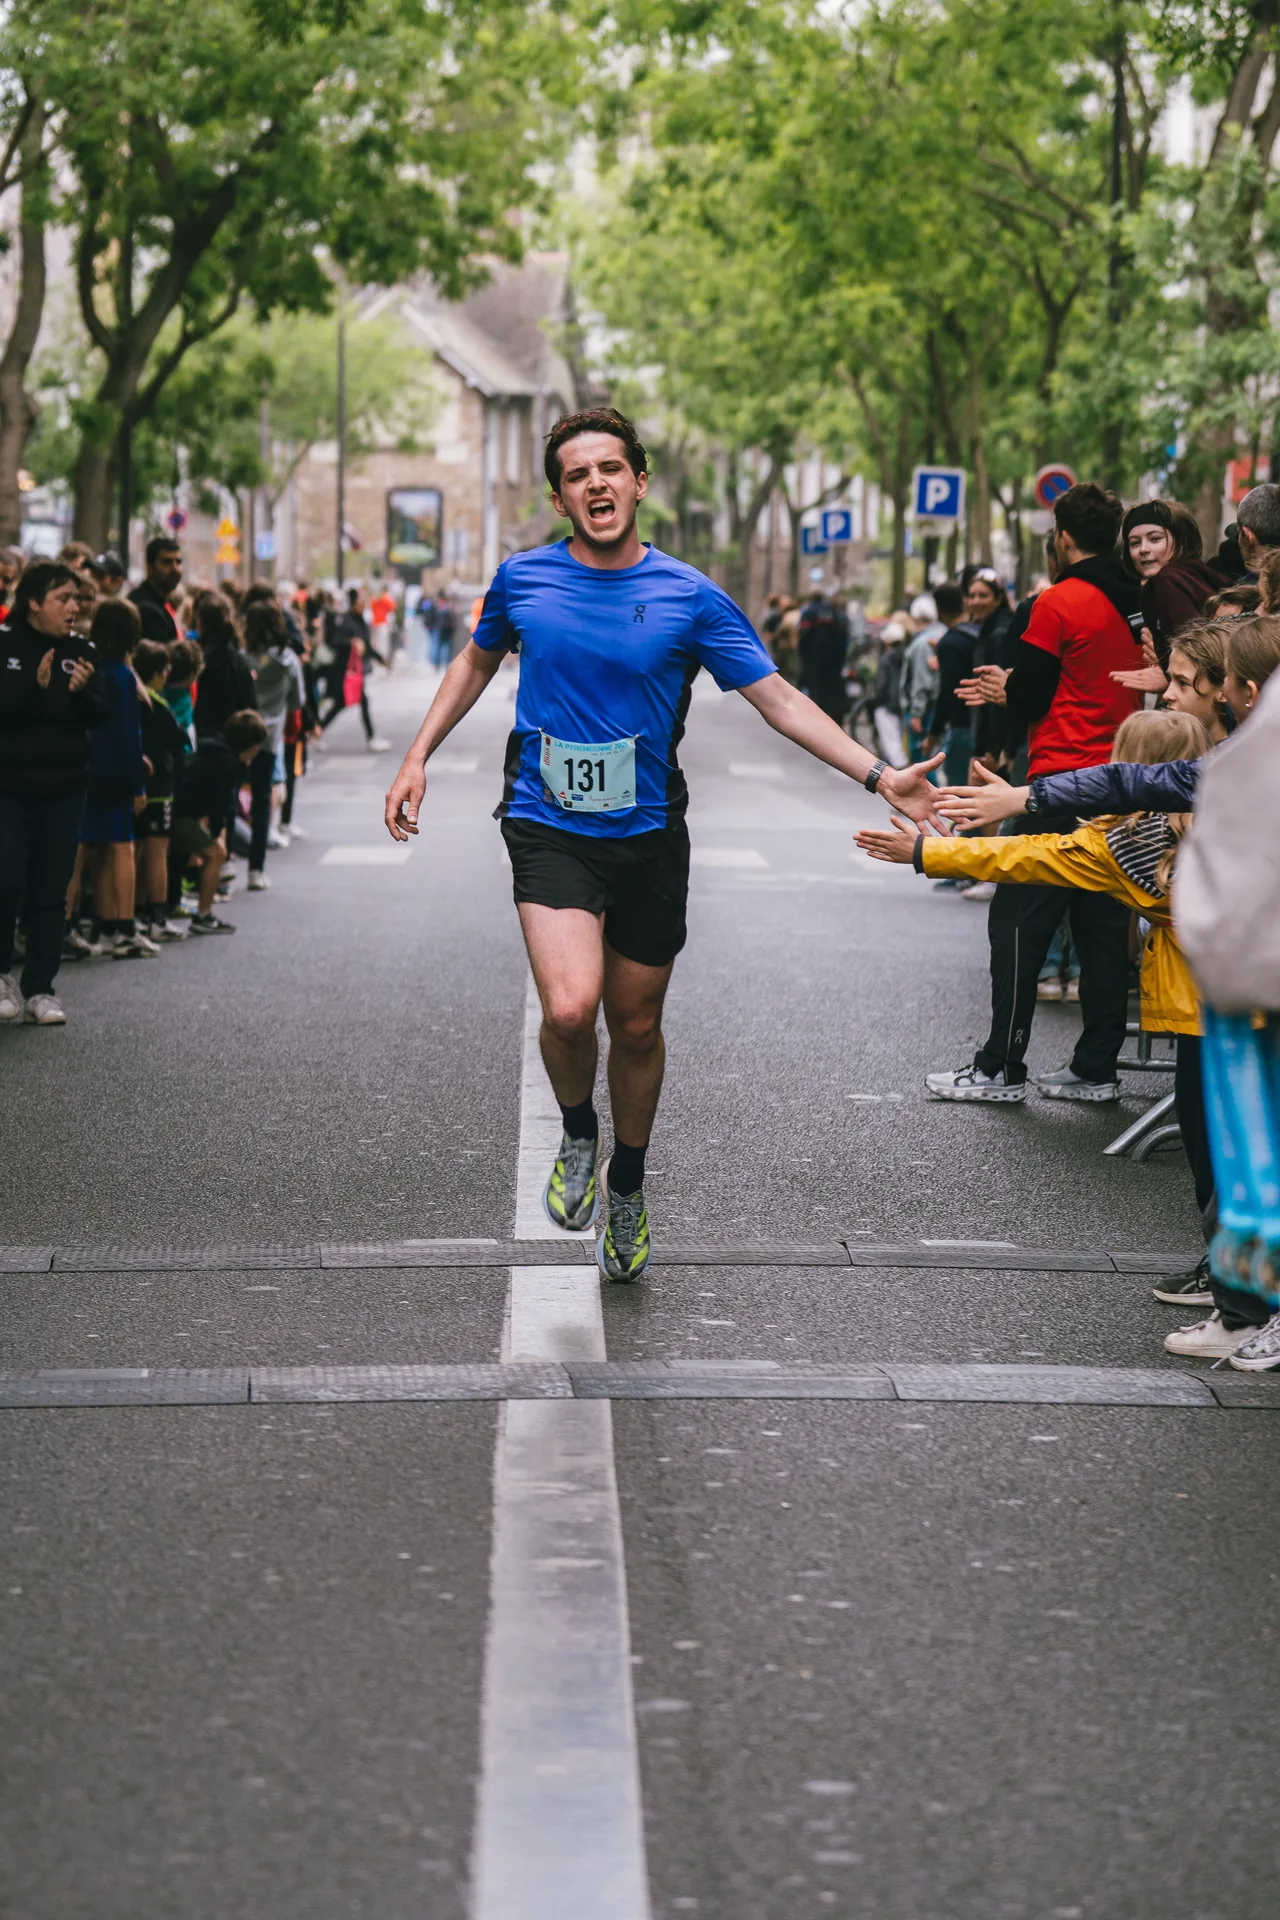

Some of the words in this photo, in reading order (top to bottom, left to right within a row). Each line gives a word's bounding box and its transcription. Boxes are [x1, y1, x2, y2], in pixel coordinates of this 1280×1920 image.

[926, 478, 950, 511] P
[827, 512, 846, 539] P
[564, 758, 605, 792] 131
